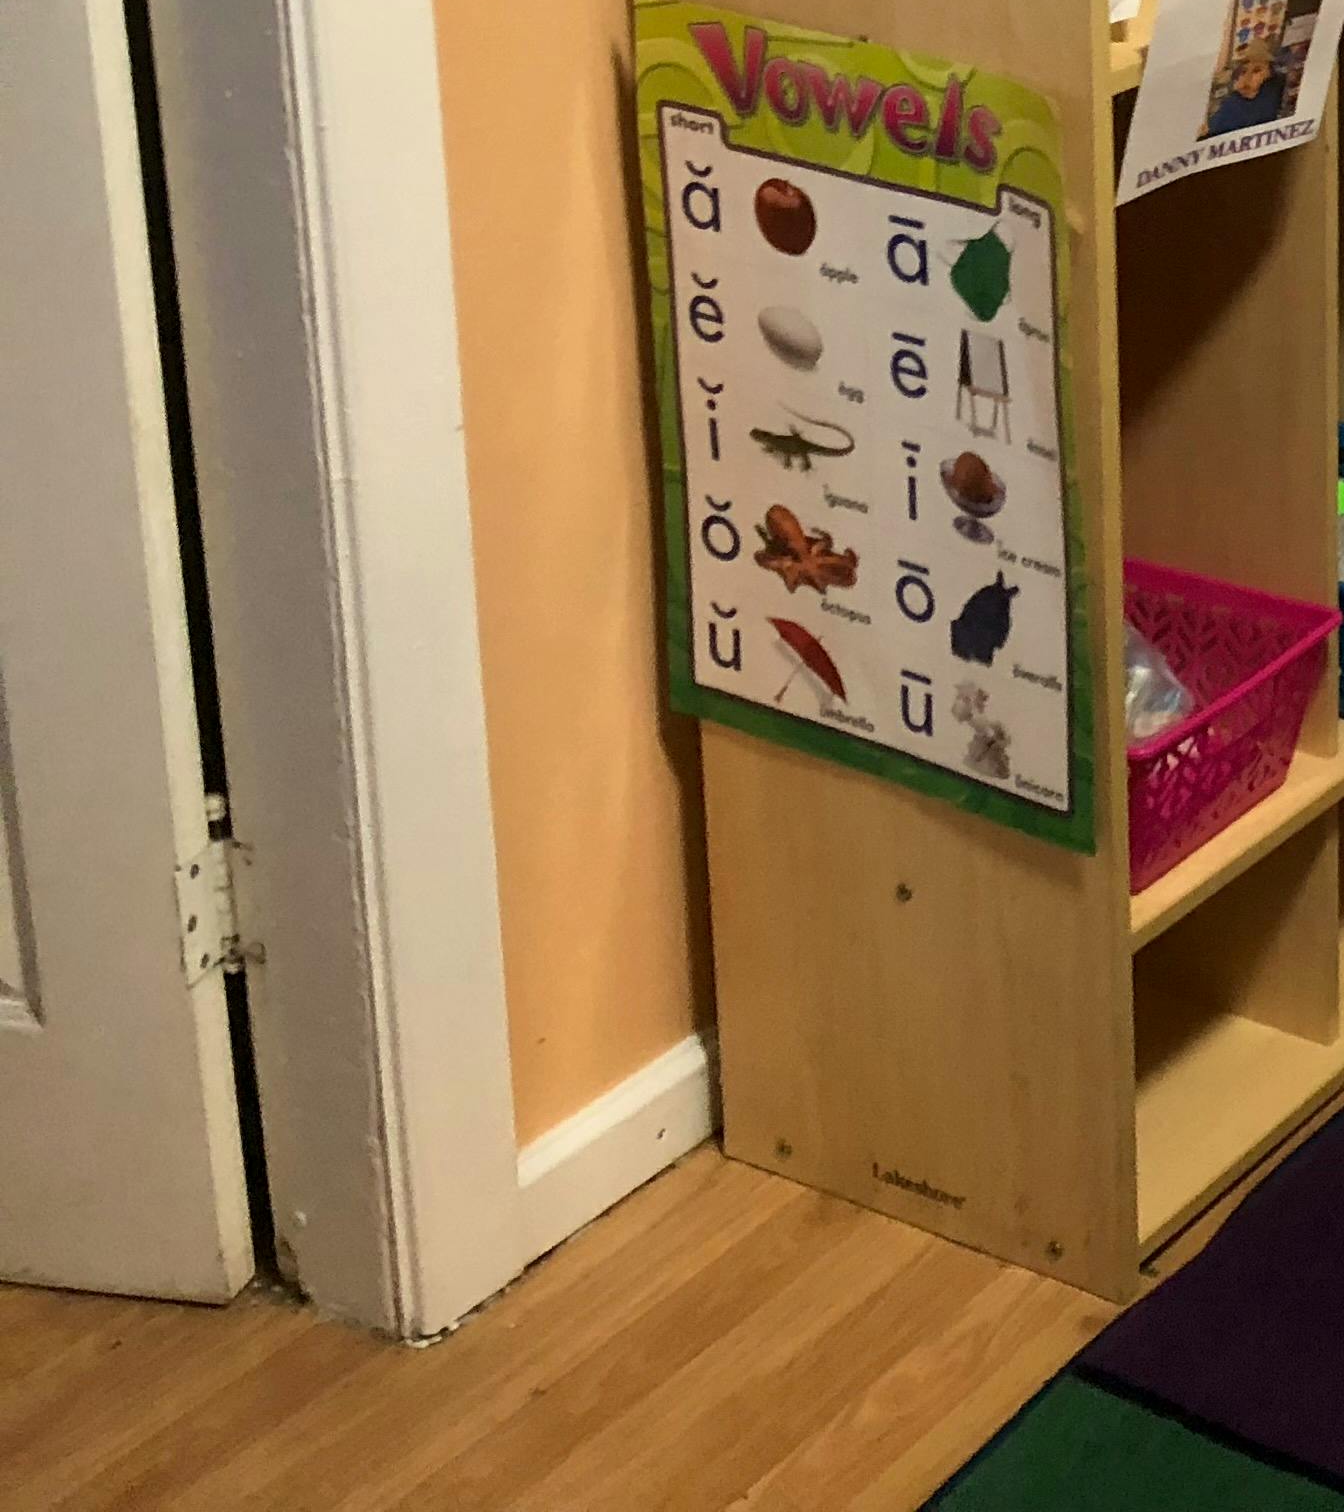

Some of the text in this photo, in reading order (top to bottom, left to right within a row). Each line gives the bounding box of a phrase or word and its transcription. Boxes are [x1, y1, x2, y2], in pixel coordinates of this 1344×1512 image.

[688, 21, 1003, 173] Vowels
[1136, 119, 1316, 188] DANNY MARTINEZ
